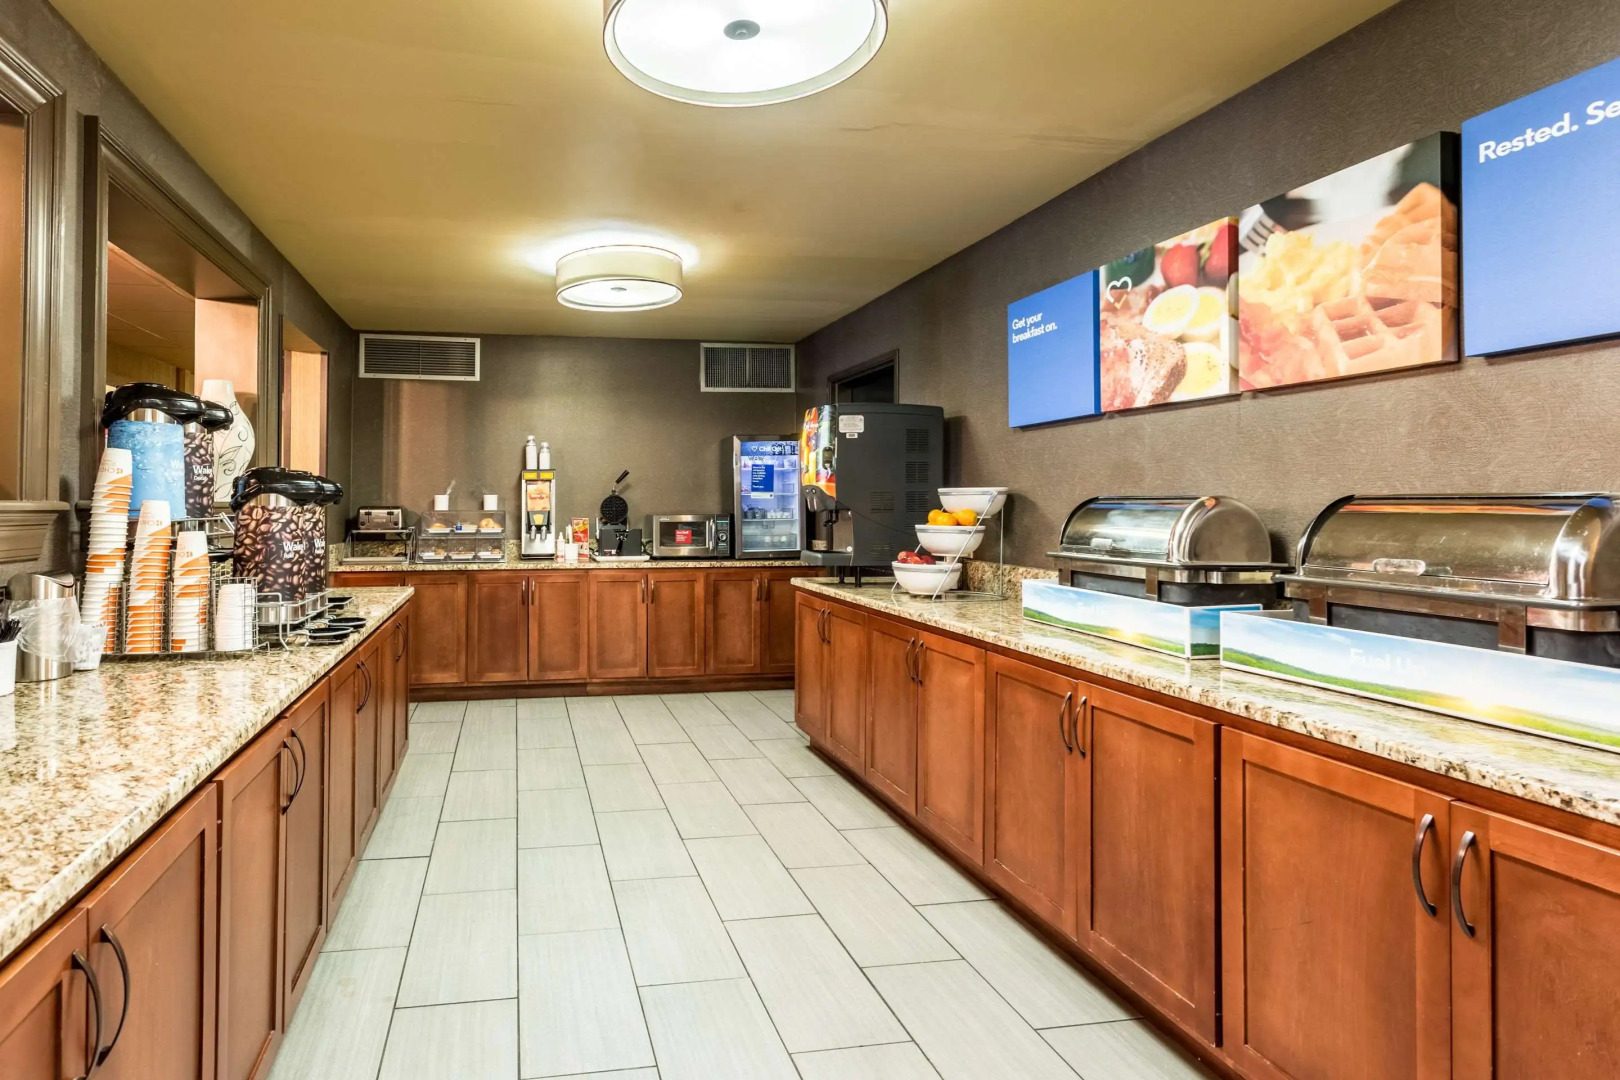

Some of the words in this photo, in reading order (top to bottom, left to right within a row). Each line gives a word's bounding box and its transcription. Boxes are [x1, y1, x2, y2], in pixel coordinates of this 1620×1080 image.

[1478, 111, 1579, 164] Rested.
[1584, 99, 1620, 126] Se
[1012, 317, 1026, 331] Get
[1026, 311, 1043, 328] your
[1012, 325, 1045, 344] breakfast
[1045, 321, 1058, 334] on.
[1349, 647, 1391, 671] Fuel
